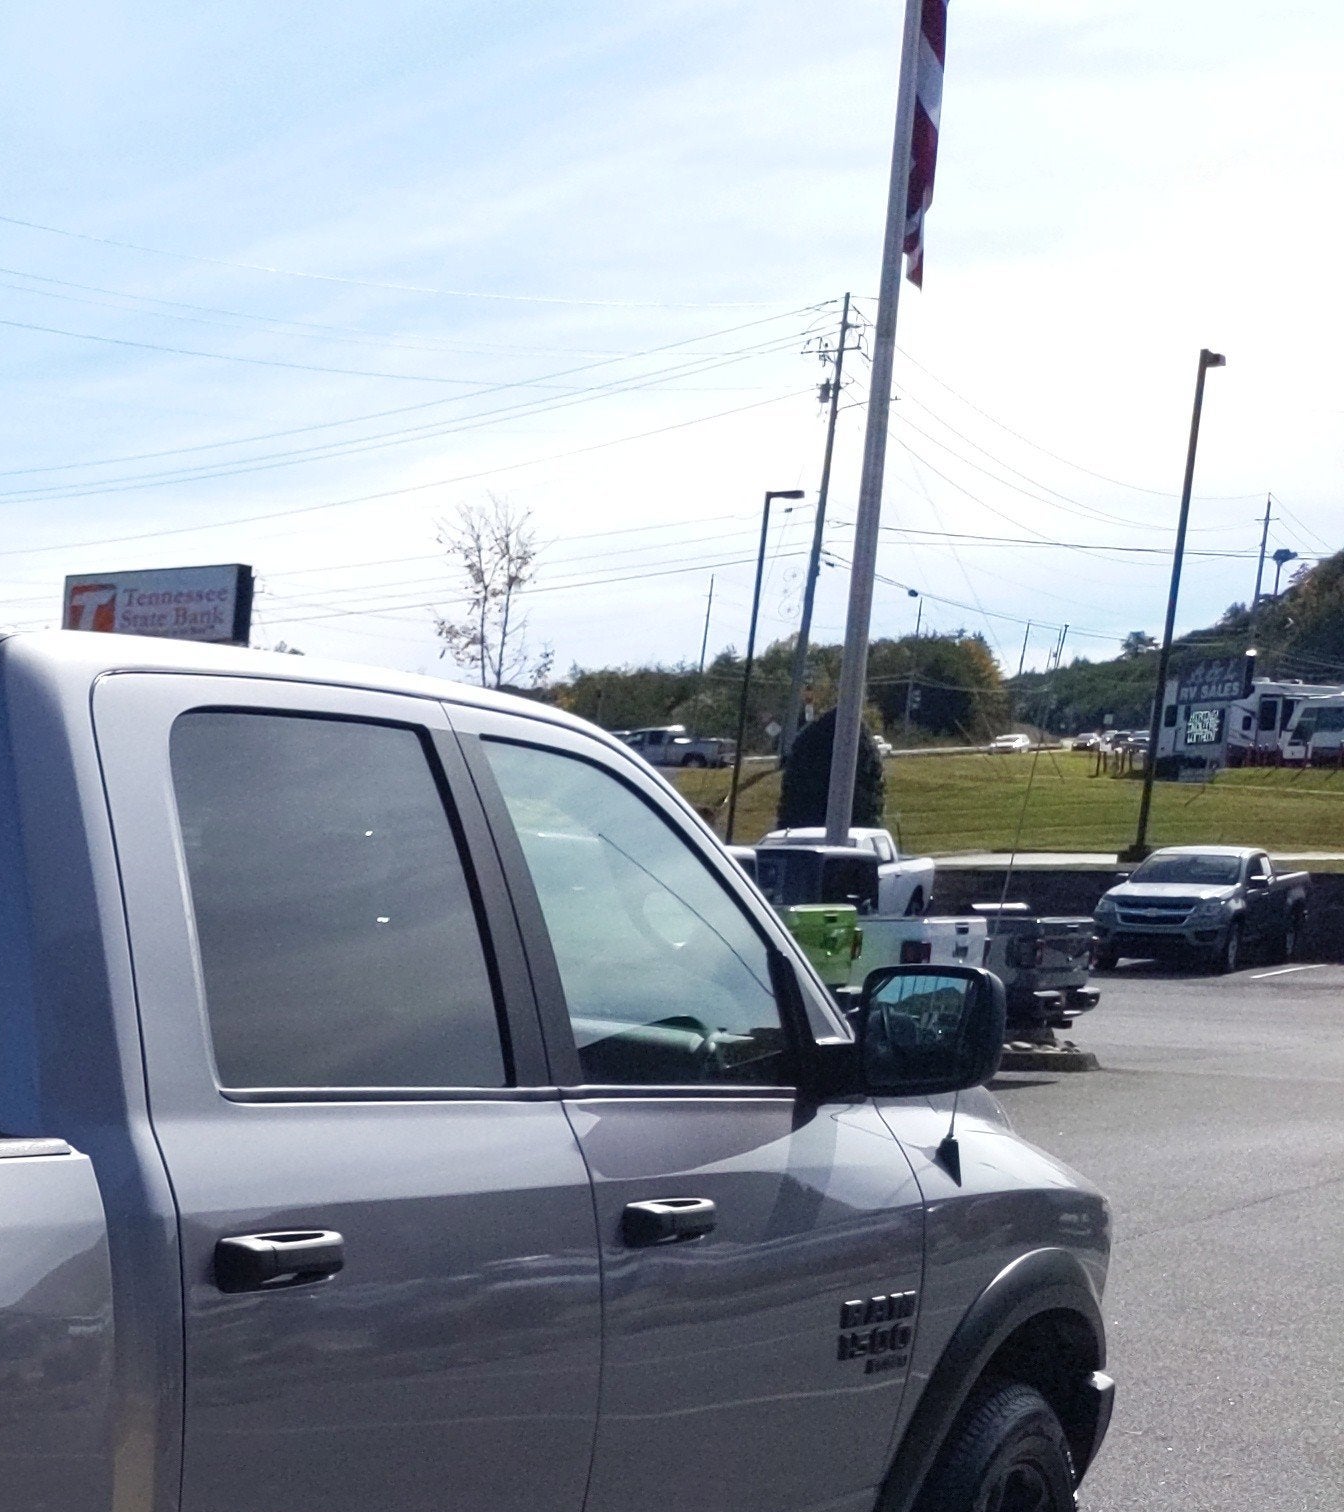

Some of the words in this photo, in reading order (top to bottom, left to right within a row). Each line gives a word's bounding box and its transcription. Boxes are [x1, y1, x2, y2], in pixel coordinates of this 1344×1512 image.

[122, 587, 228, 607] Tennessee
[121, 609, 167, 628] State
[173, 606, 225, 626] Bank
[1180, 686, 1198, 700] RV
[1200, 682, 1241, 700] SALES
